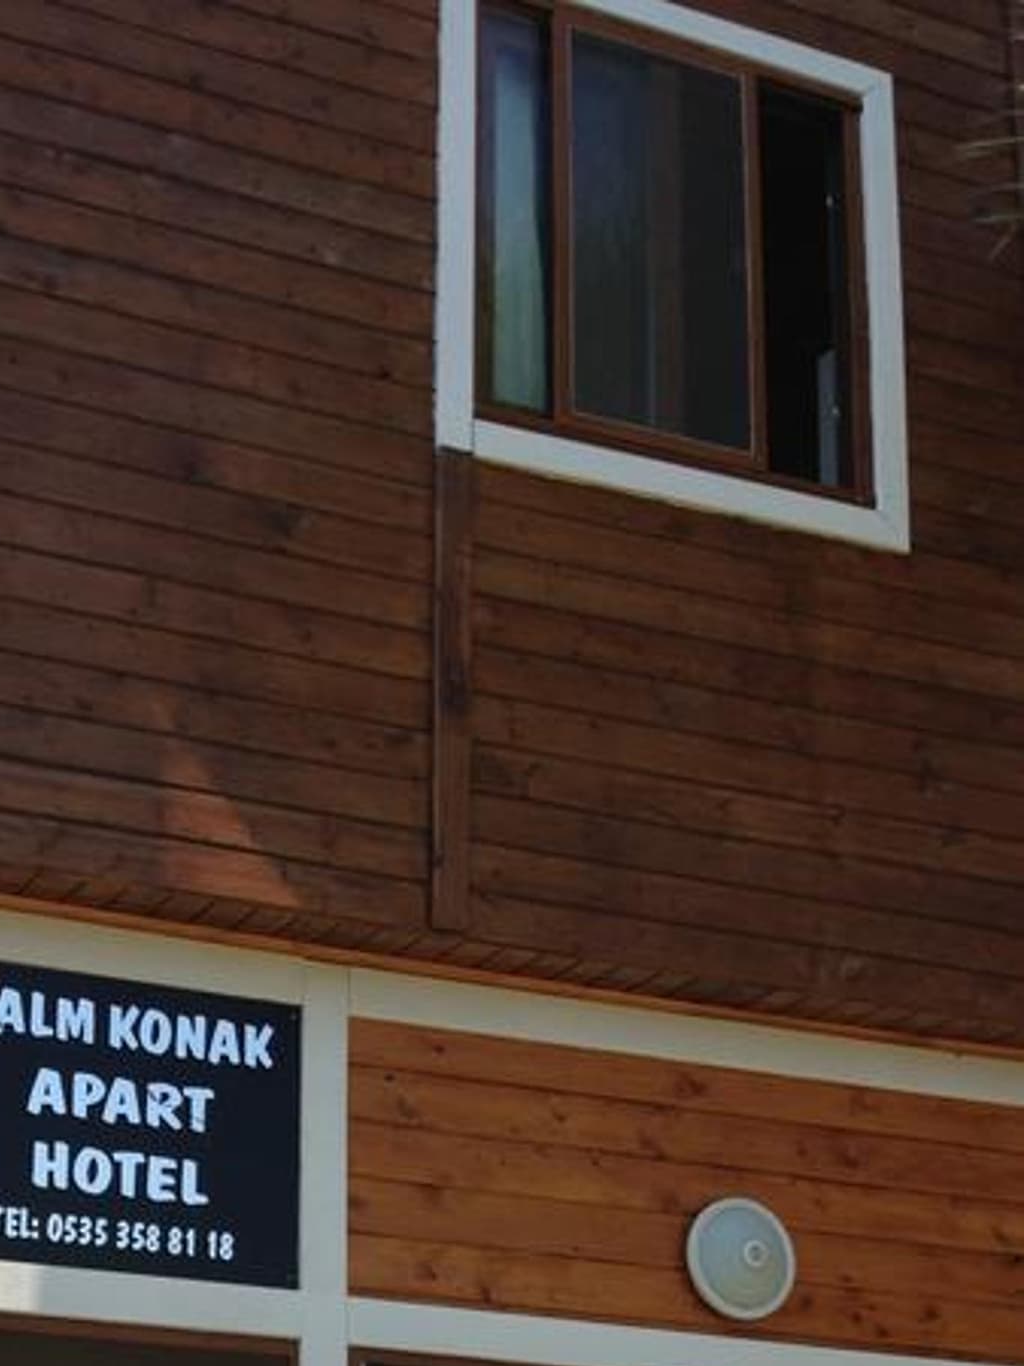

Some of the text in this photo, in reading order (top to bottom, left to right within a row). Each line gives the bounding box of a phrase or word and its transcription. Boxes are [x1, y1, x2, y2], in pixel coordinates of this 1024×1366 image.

[109, 1003, 274, 1070] KONAK
[26, 1067, 215, 1133] APART
[31, 1141, 209, 1206] HOTEL
[46, 1212, 108, 1246] 0535
[116, 1220, 161, 1253] 358
[167, 1226, 195, 1258] 81
[207, 1231, 235, 1261] 18
